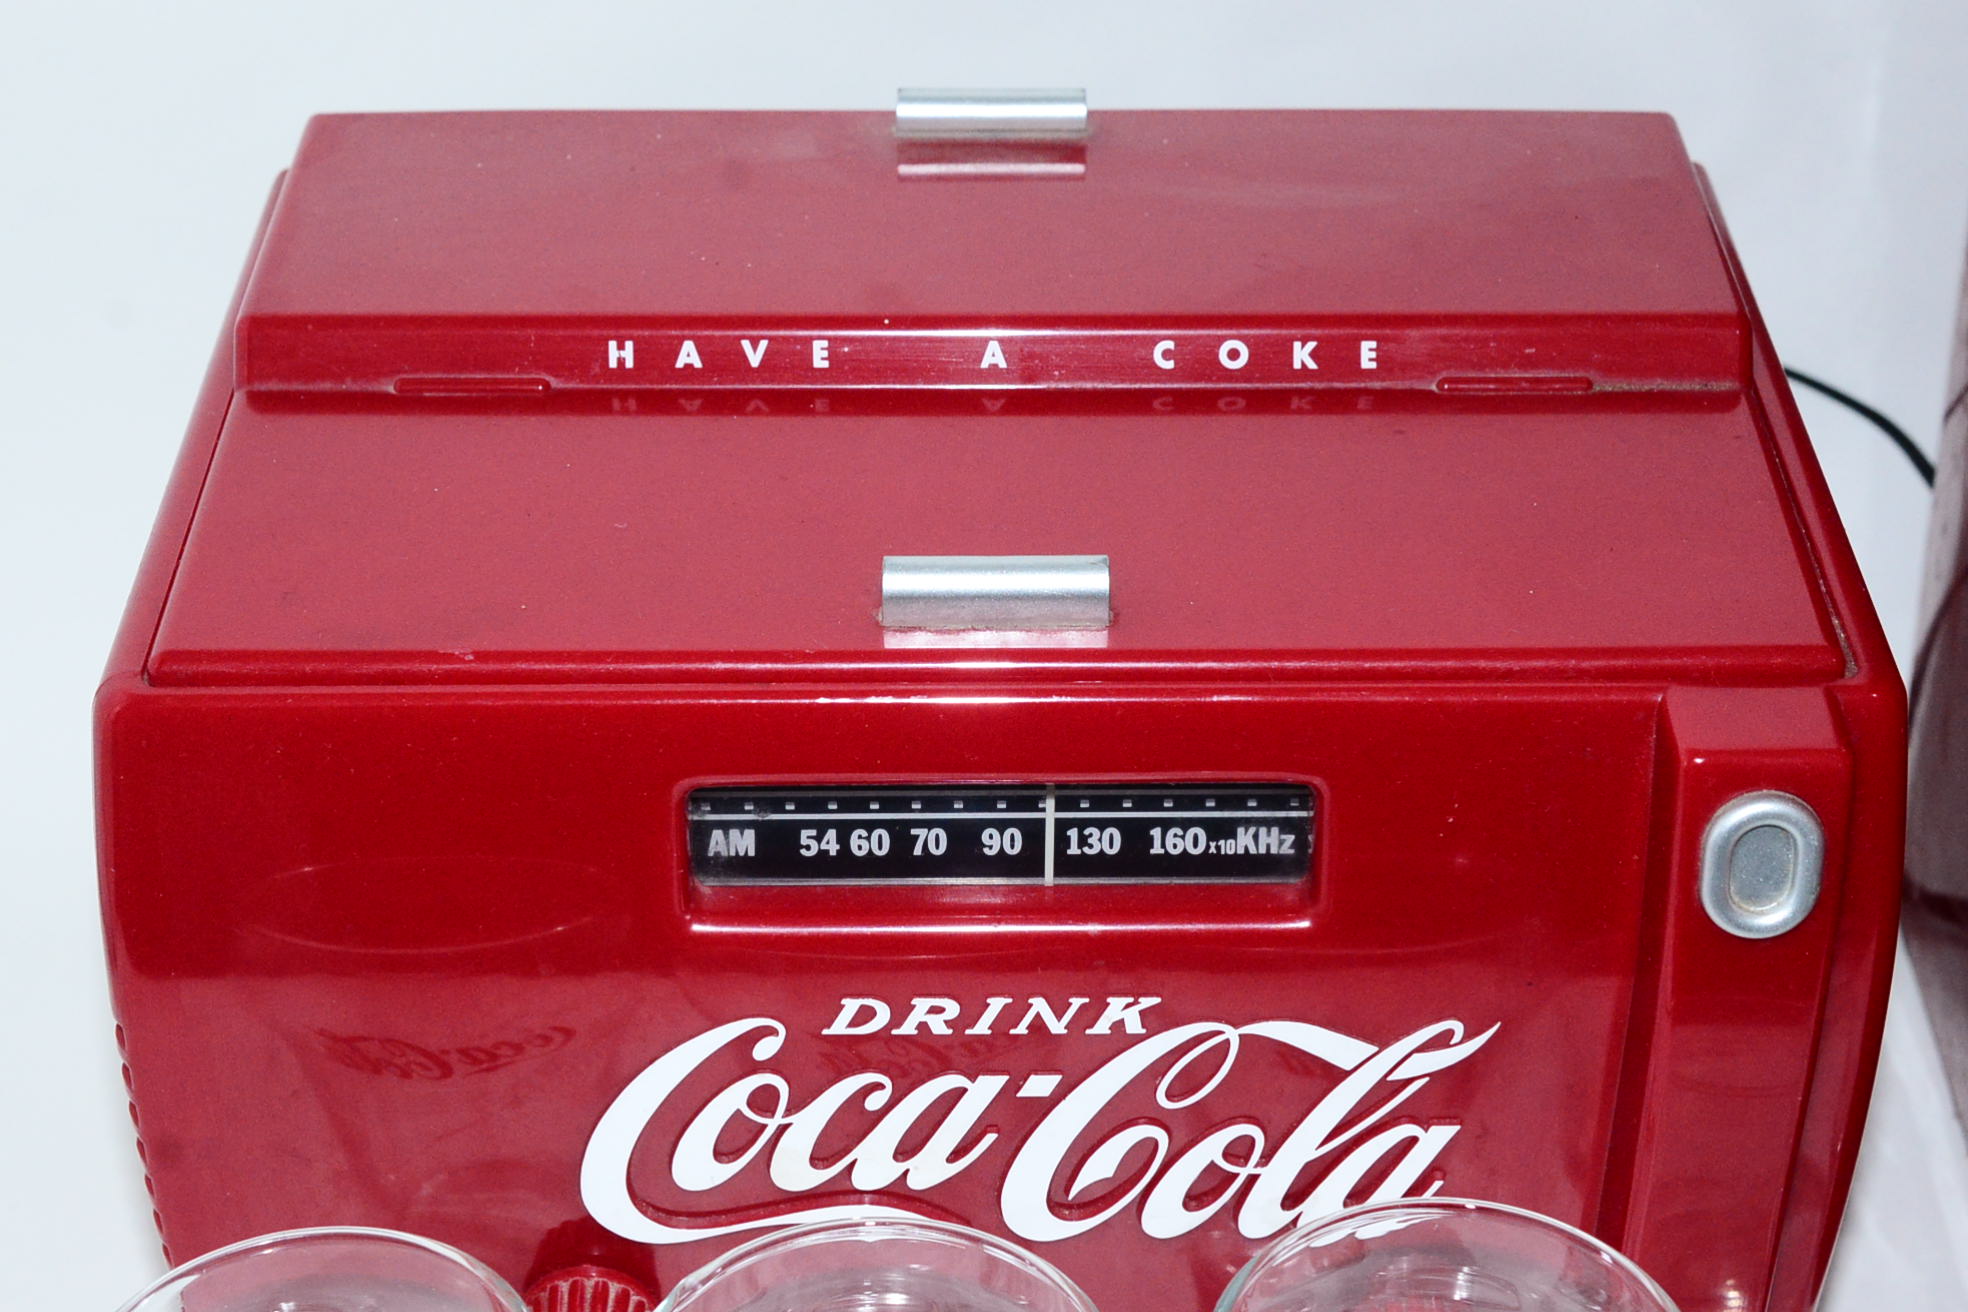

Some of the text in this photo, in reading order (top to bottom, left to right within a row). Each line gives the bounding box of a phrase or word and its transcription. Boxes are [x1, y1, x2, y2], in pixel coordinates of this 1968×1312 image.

[608, 339, 1377, 370] HAVE A COKE
[708, 829, 756, 857] AM
[799, 829, 841, 857] 54
[849, 828, 891, 857] 60
[910, 828, 948, 857] 70
[981, 828, 1023, 856] 90
[1066, 827, 1122, 856] 130
[821, 997, 1162, 1035] DRINK
[580, 1016, 1502, 1243] Coca-Cola
